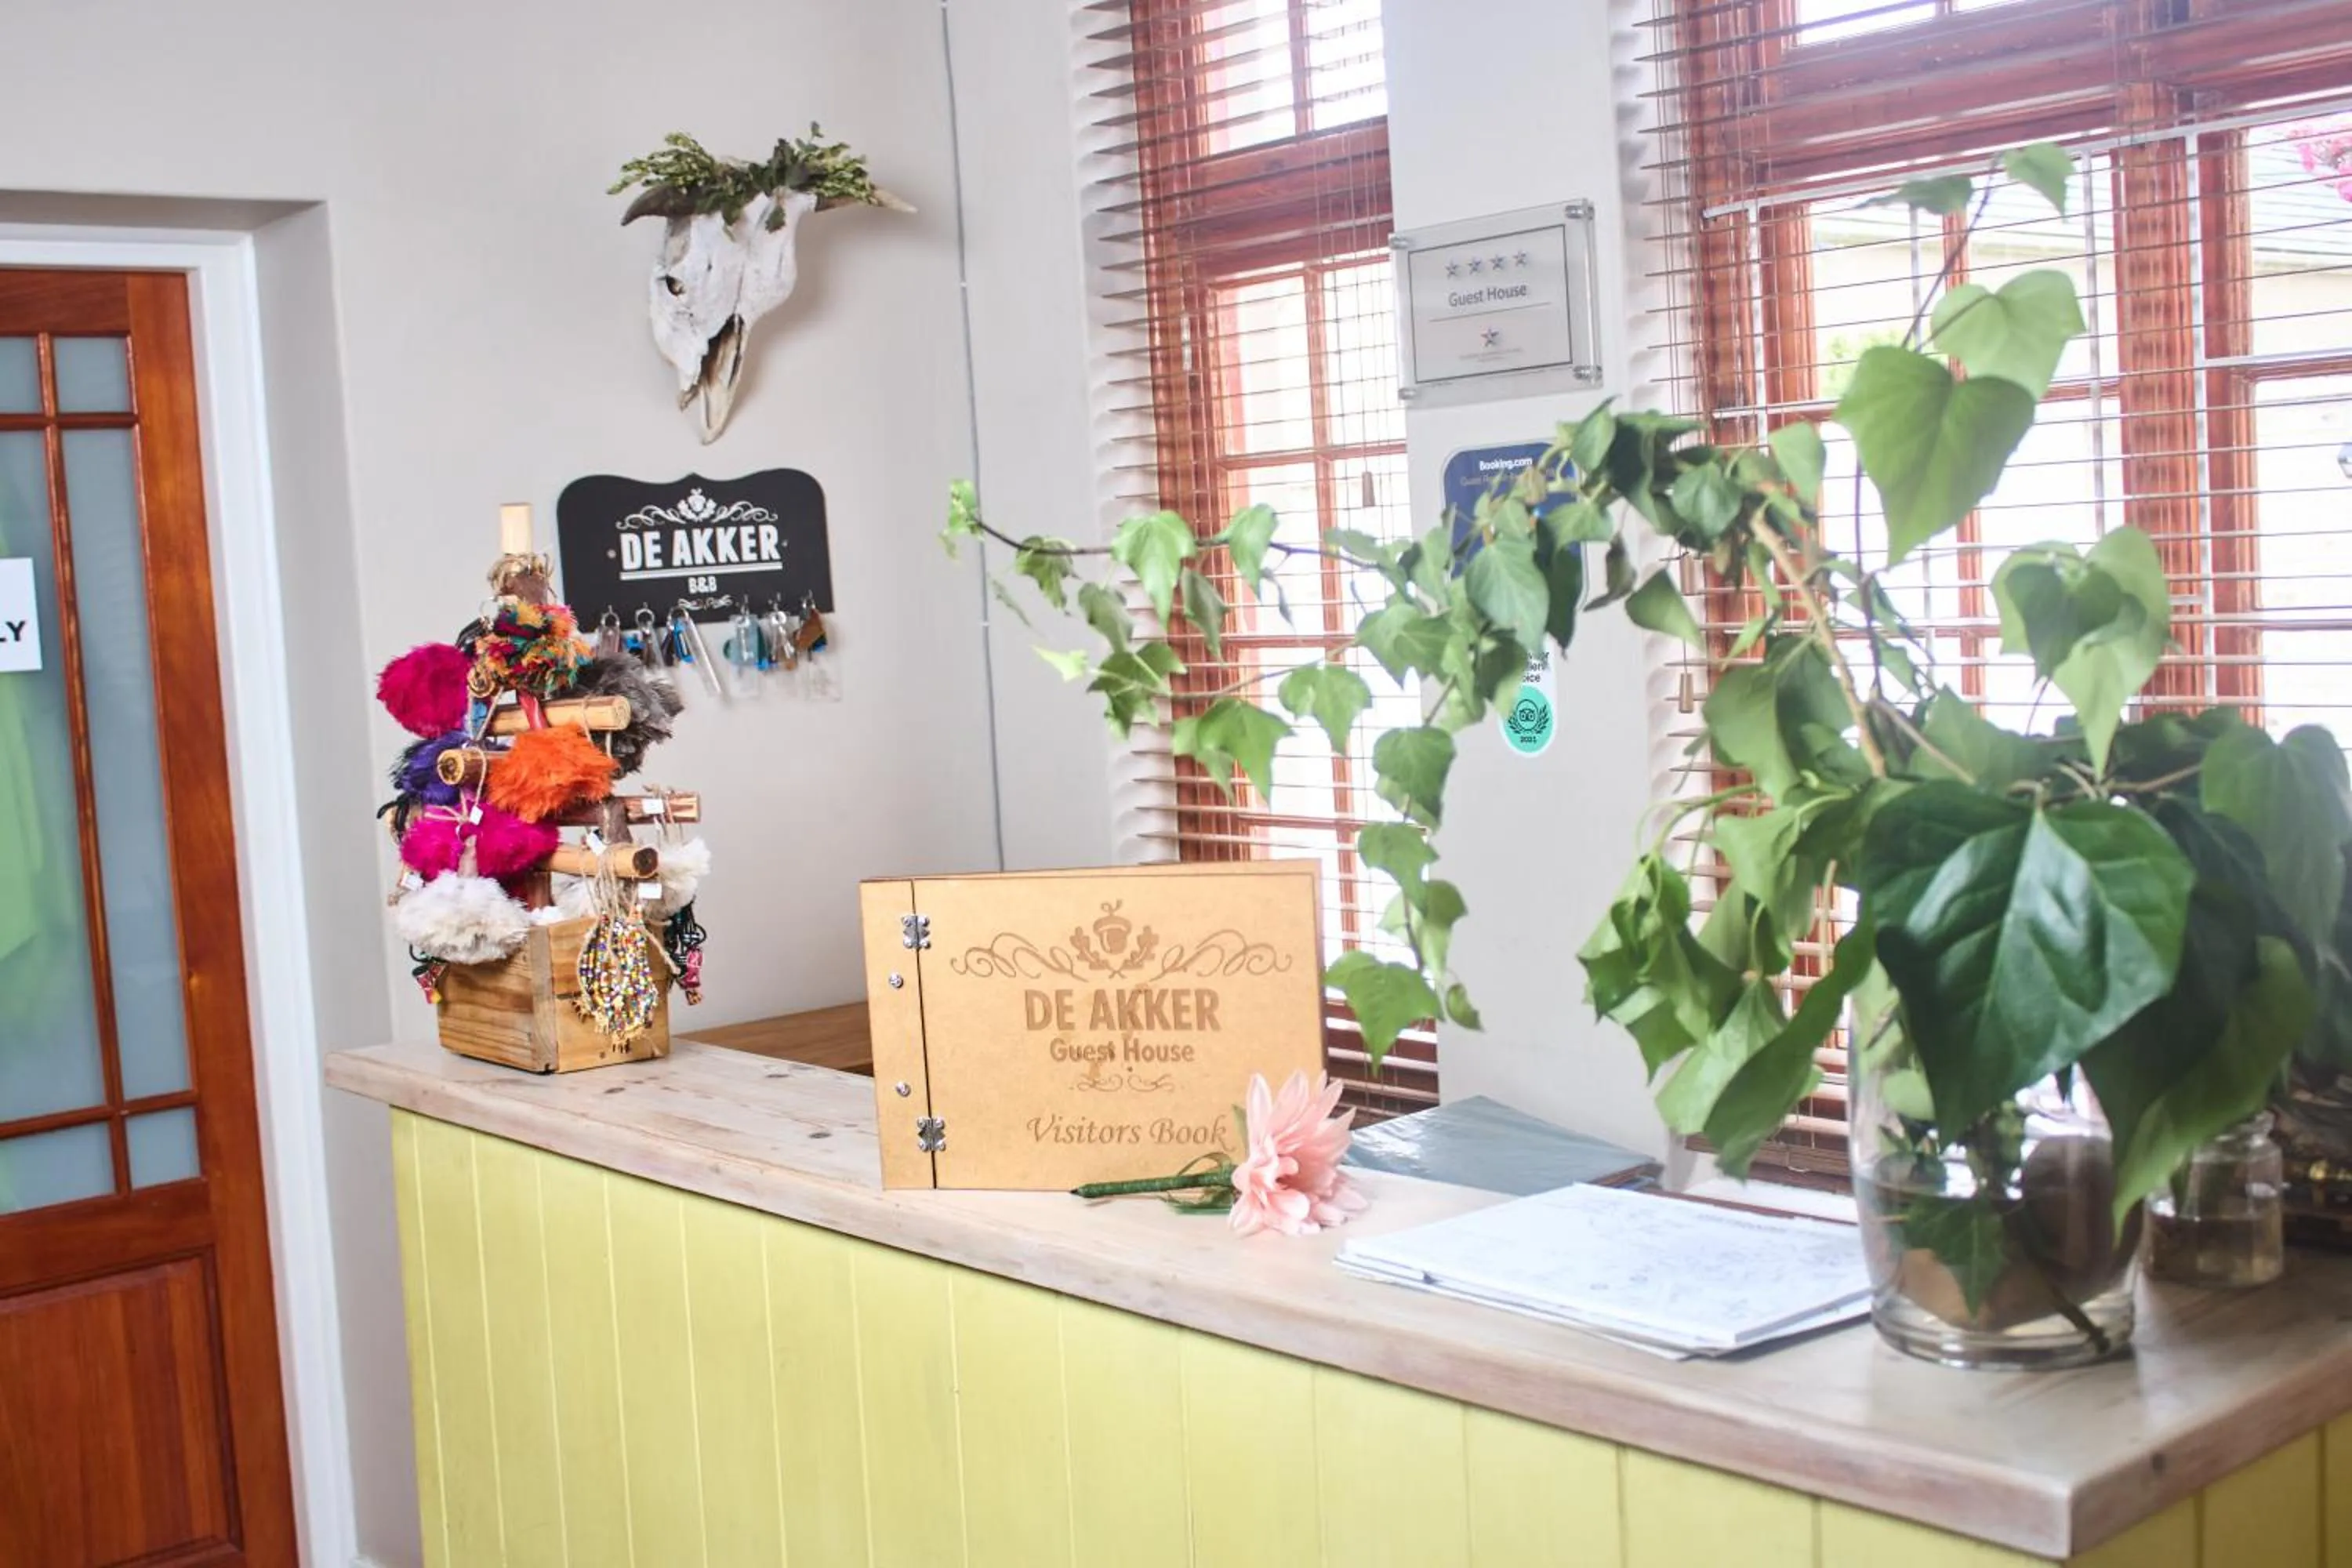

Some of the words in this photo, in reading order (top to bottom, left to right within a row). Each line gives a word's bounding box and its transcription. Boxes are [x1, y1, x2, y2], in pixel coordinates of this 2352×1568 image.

[1448, 290, 1483, 307] Guest
[1486, 284, 1527, 301] House
[1479, 457, 1533, 471] Booking.com
[619, 530, 662, 571] DE
[672, 524, 782, 567] AKKER
[688, 575, 717, 593] B&B
[1024, 989, 1075, 1031] DE
[1088, 987, 1222, 1032] AKKER
[1049, 1037, 1116, 1062] Guest
[1123, 1037, 1196, 1062] House
[1025, 1114, 1142, 1145] Visitors
[1149, 1113, 1236, 1152] Book
